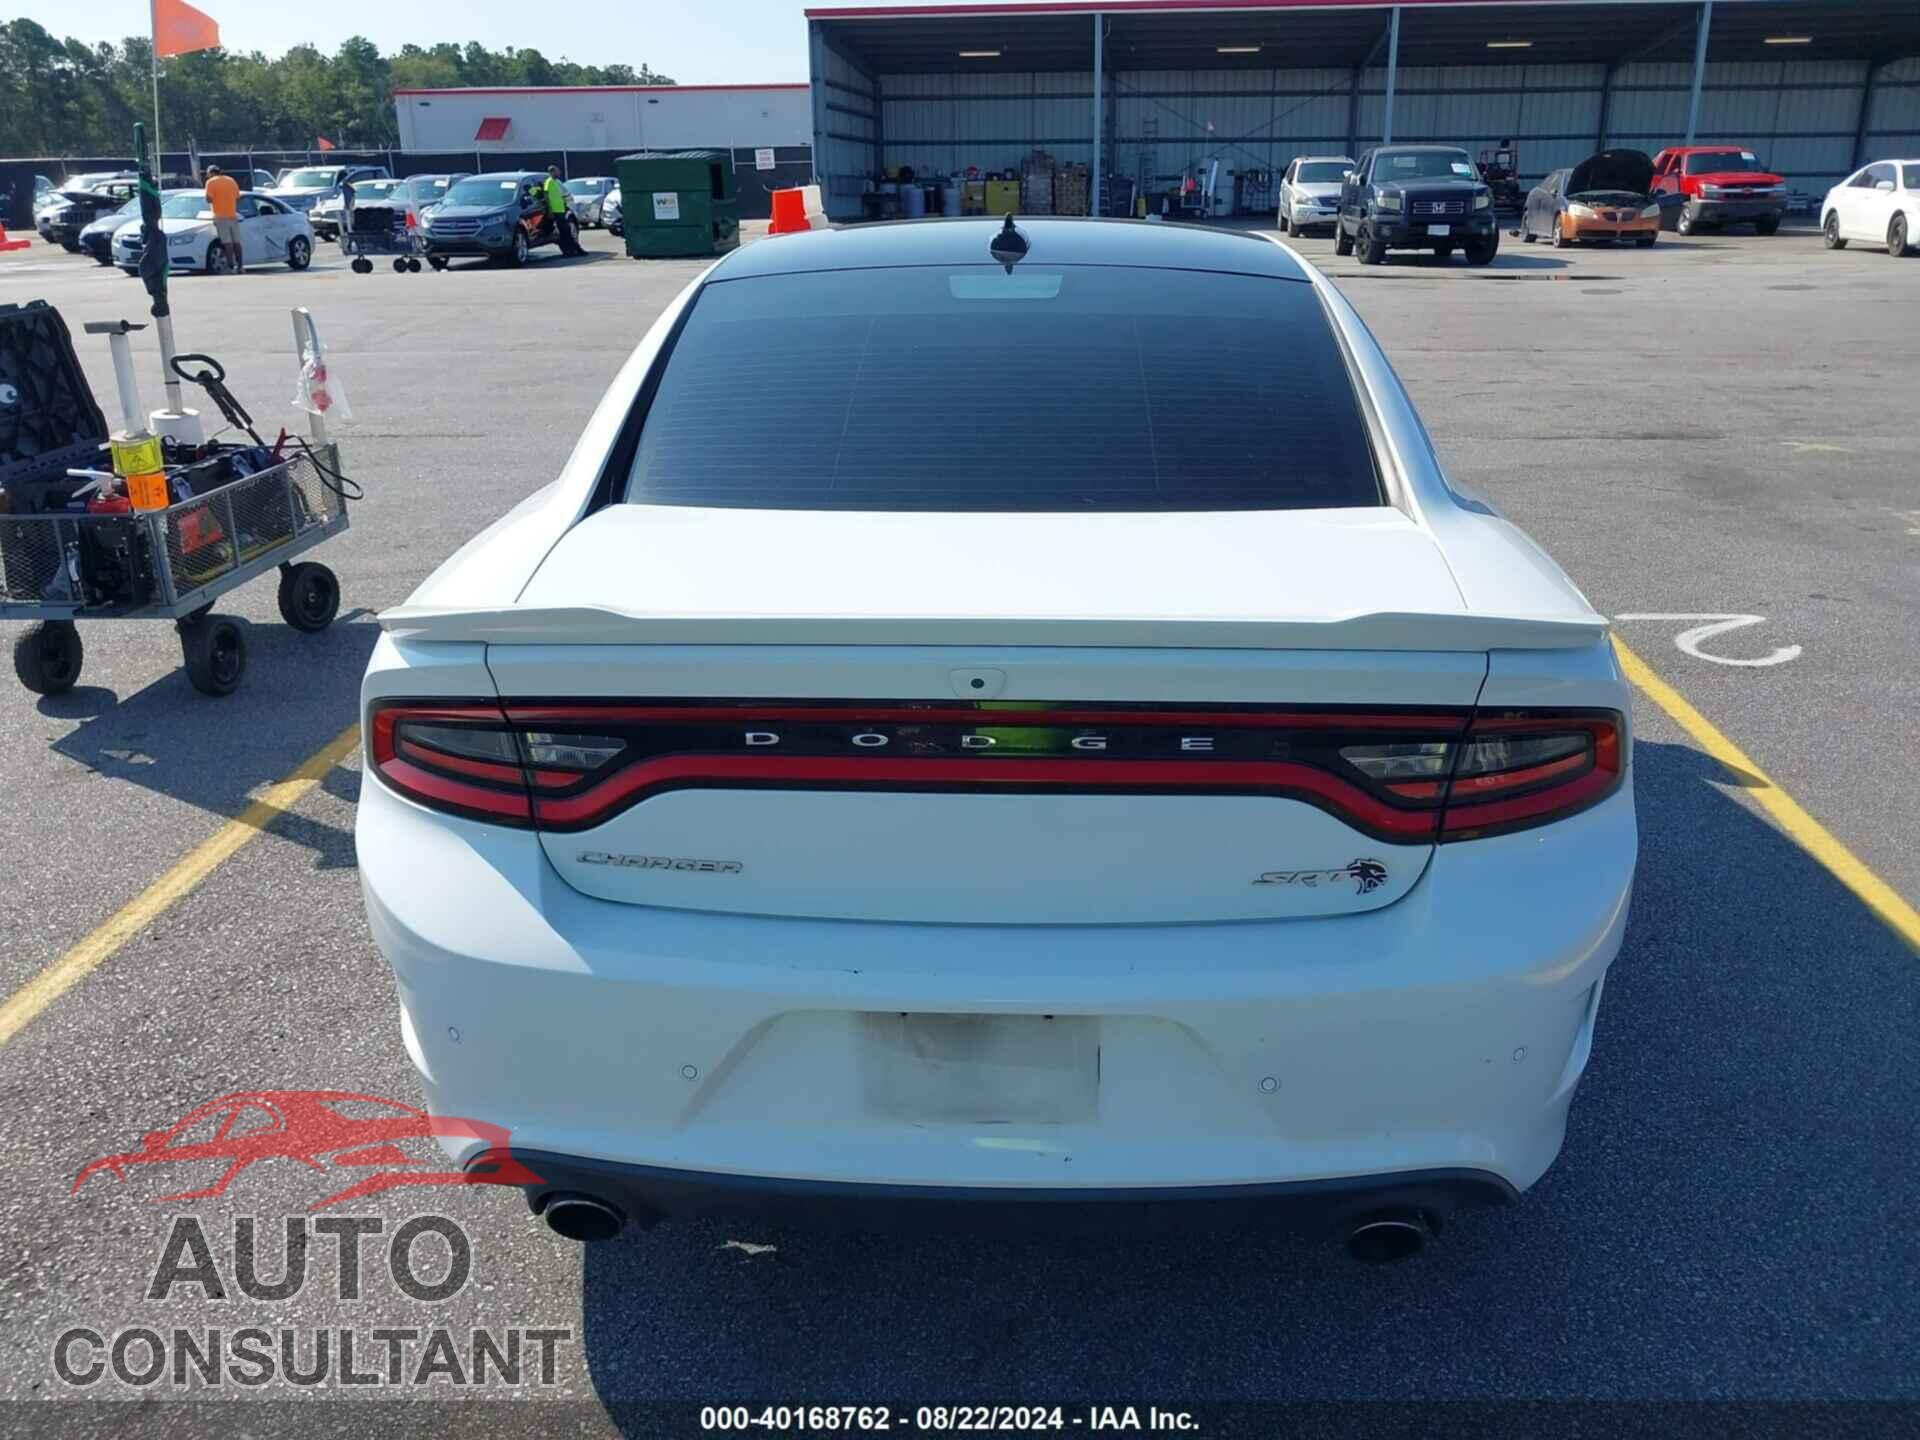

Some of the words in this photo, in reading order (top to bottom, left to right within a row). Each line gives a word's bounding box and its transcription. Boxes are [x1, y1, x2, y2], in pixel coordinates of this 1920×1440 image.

[745, 732, 1214, 750] DODGE
[576, 851, 744, 874] CHARGER
[1251, 868, 1358, 887] SRT
